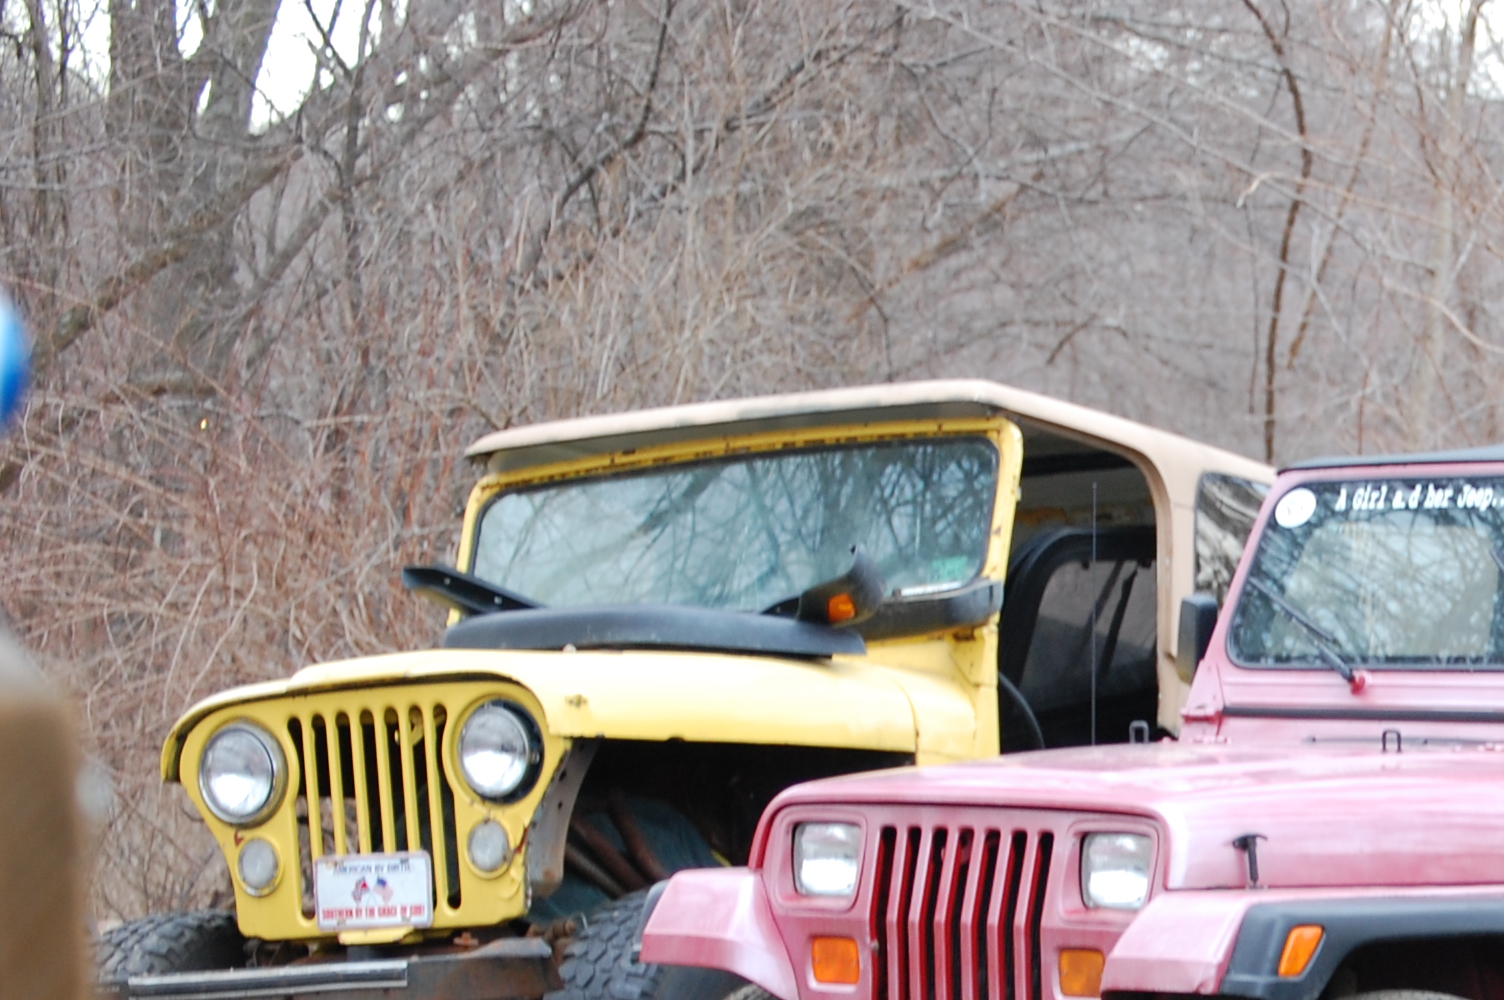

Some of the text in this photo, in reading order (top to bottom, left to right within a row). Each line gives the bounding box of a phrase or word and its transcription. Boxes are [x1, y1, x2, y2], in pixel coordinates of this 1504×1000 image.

[1334, 486, 1347, 511] A
[1352, 482, 1388, 510] Girl
[1392, 482, 1422, 510] ad
[1423, 482, 1454, 510] her
